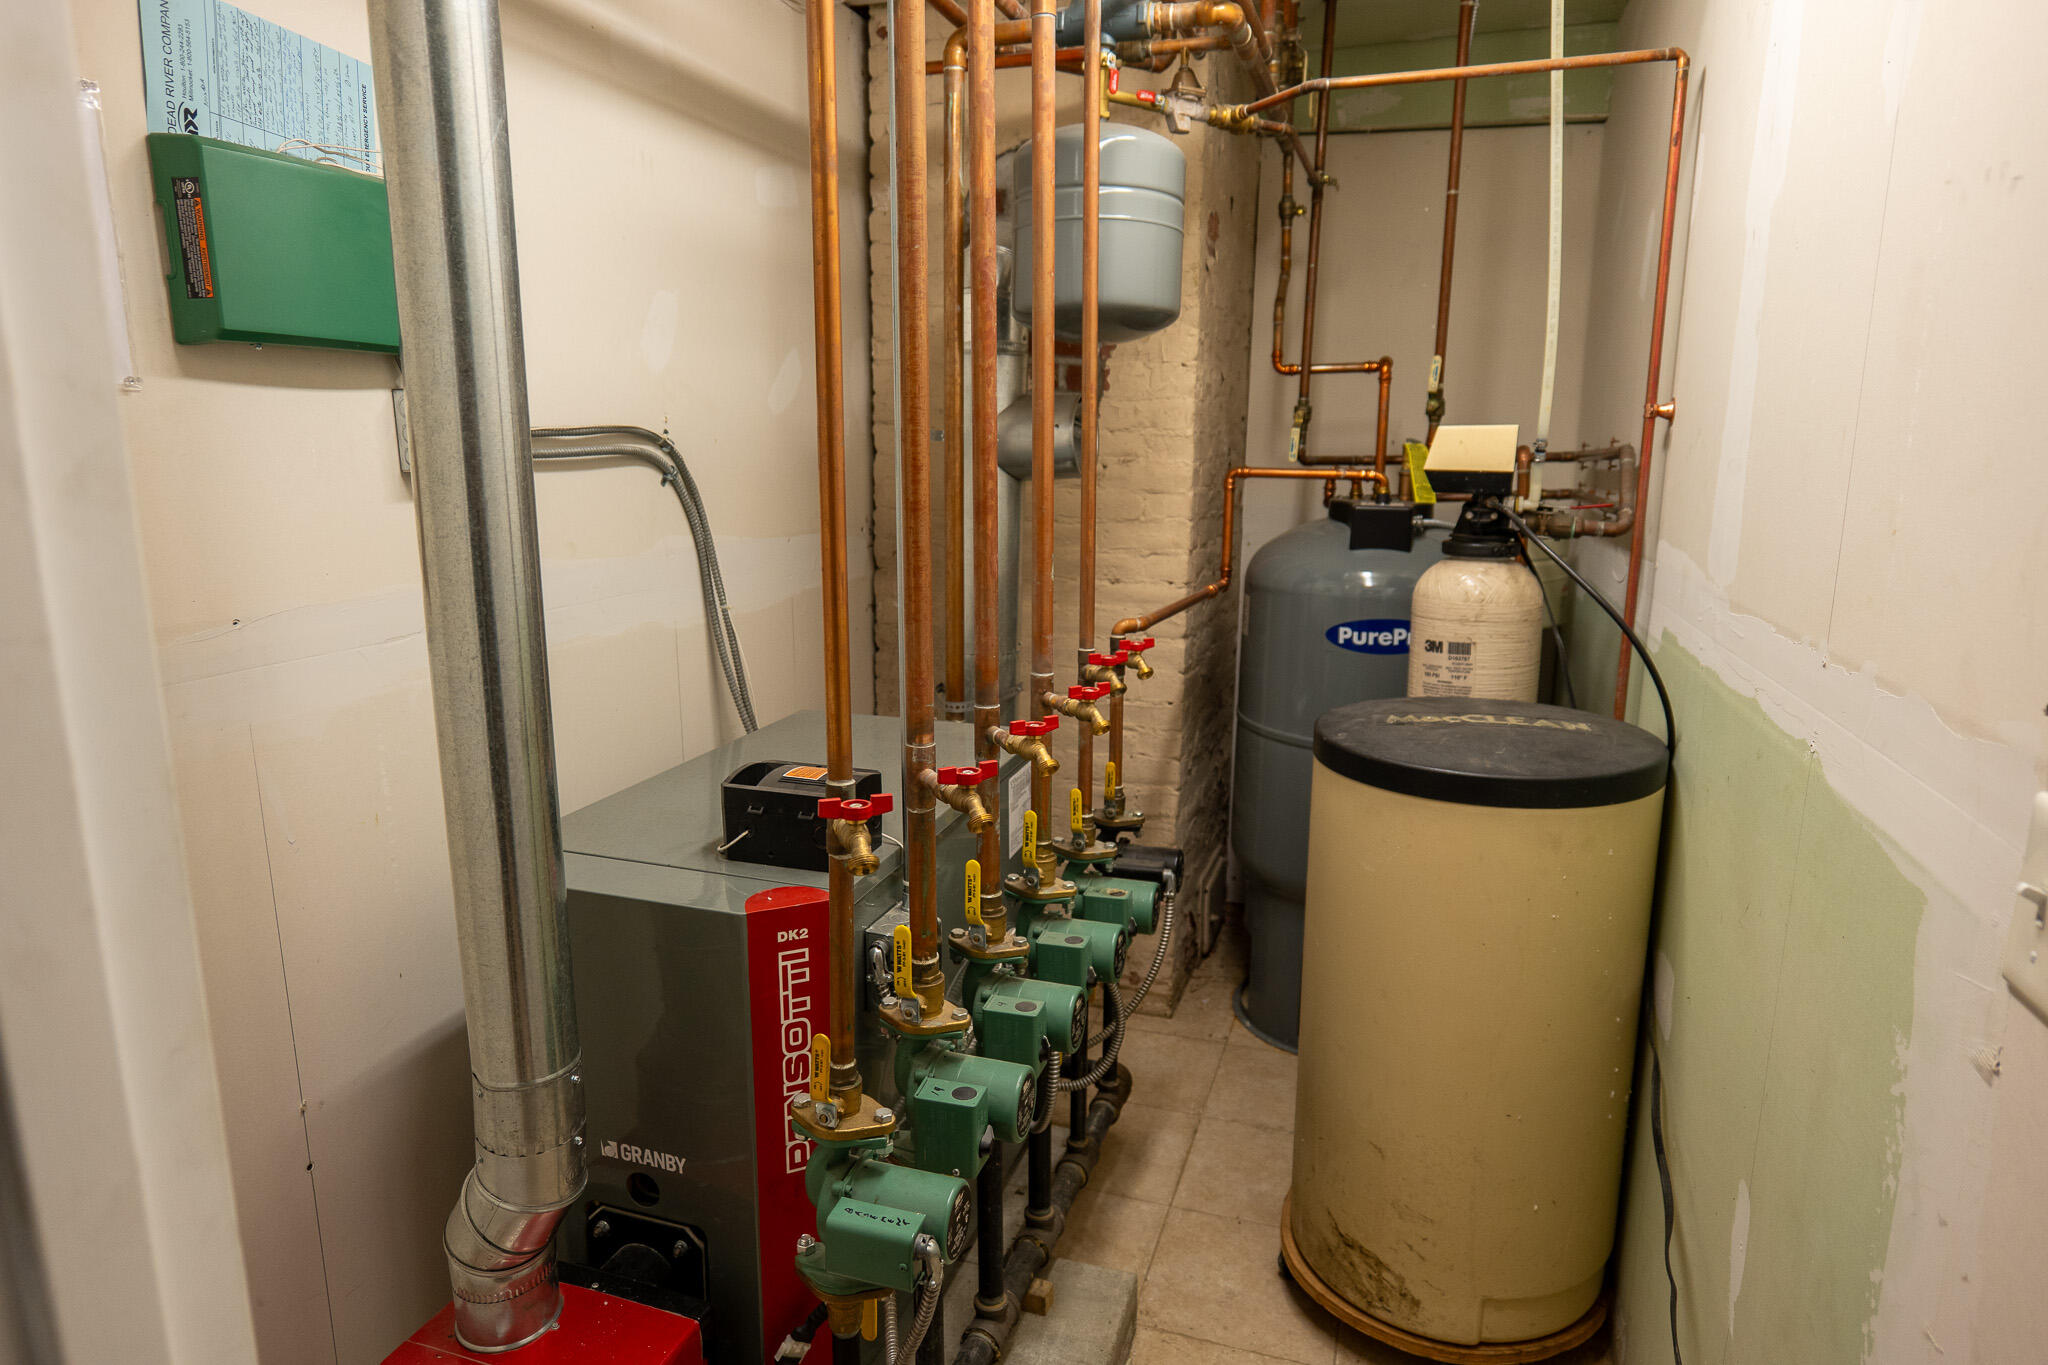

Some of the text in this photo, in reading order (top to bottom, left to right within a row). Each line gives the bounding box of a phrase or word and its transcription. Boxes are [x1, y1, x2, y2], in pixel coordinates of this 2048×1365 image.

[163, 57, 175, 98] RIVER
[166, 100, 177, 134] DEAD
[196, 207, 205, 241] WARNING
[1424, 639, 1443, 654] 3M
[777, 928, 809, 943] DK2
[620, 1143, 686, 1175] GRANBY
